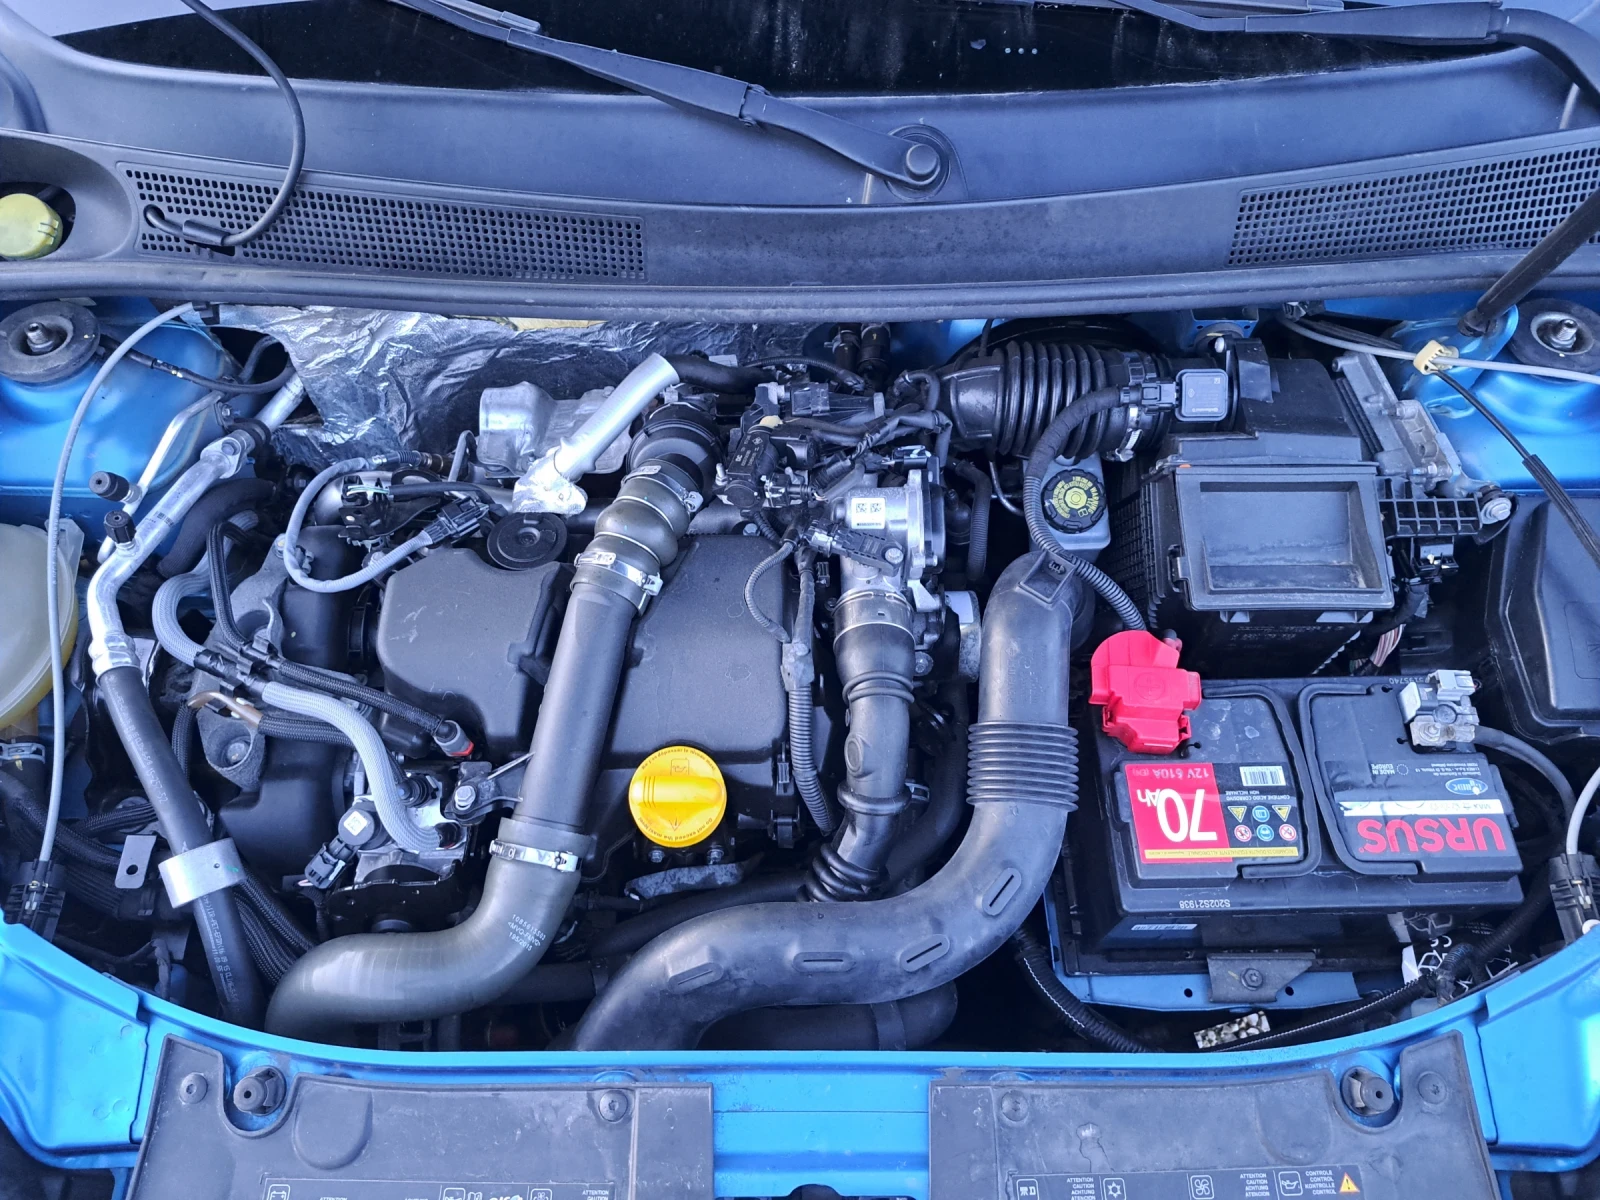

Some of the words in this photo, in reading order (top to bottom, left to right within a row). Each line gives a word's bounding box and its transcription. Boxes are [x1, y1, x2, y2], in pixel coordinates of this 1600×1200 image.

[1152, 768, 1183, 779] 610A
[1186, 767, 1209, 778] 12V
[1356, 818, 1507, 854] URSUS
